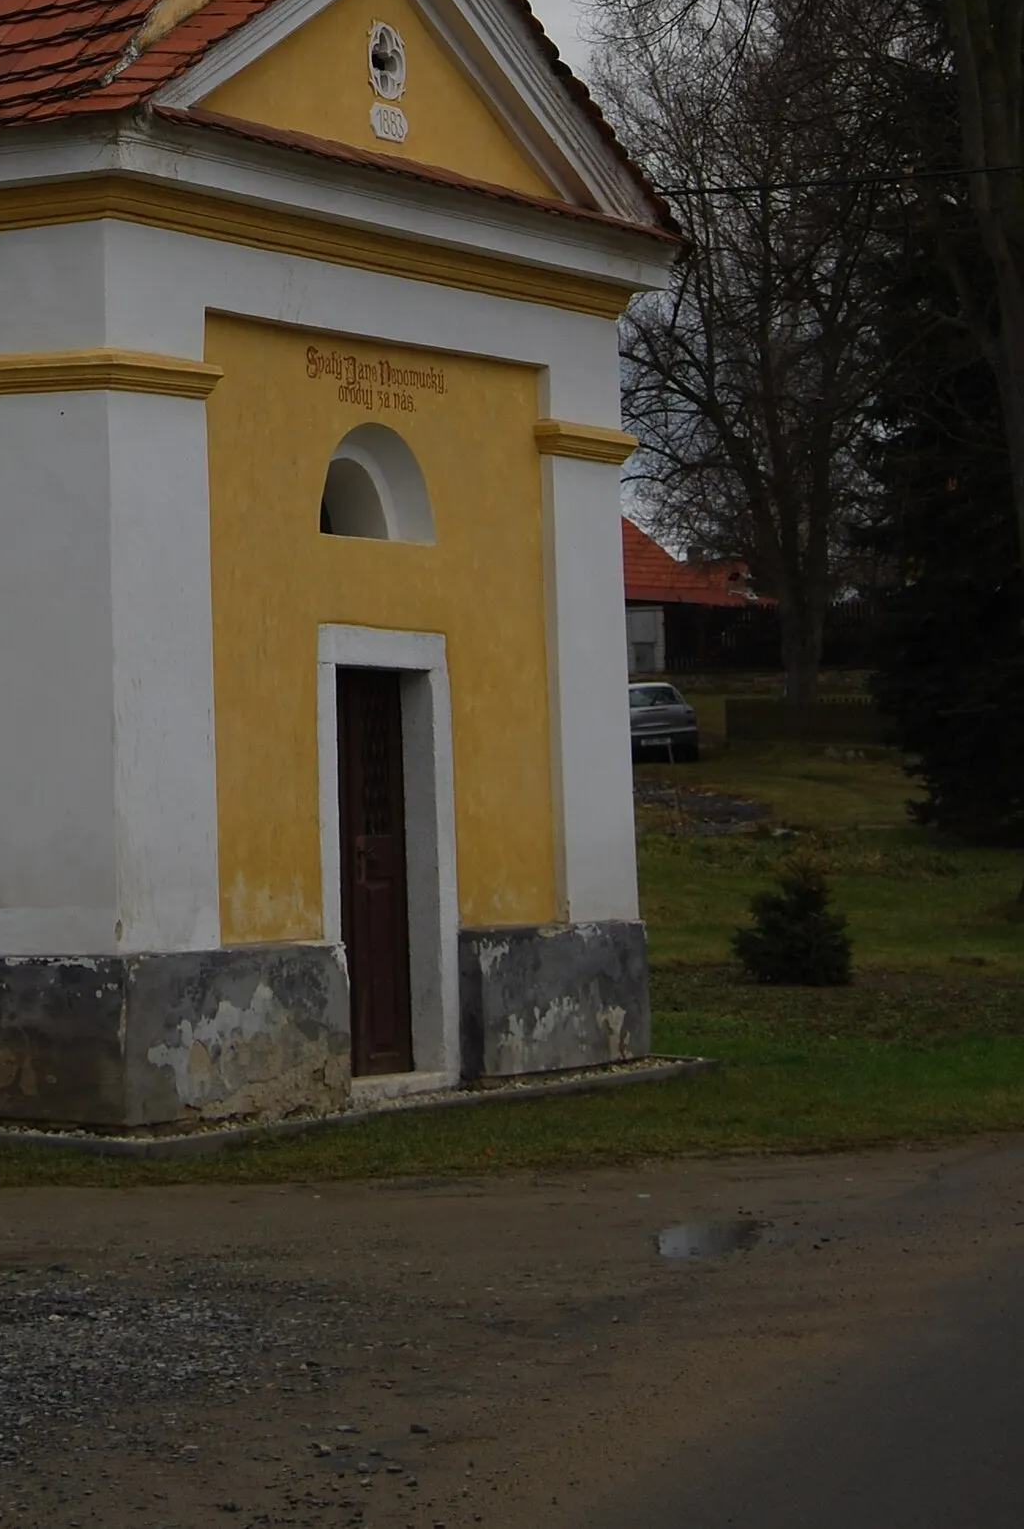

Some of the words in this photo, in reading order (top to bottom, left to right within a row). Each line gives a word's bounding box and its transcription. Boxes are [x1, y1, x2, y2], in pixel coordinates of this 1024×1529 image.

[375, 109, 405, 138] 1883
[343, 355, 377, 385] Jane
[338, 382, 373, 410] oroduj
[377, 391, 390, 412] za
